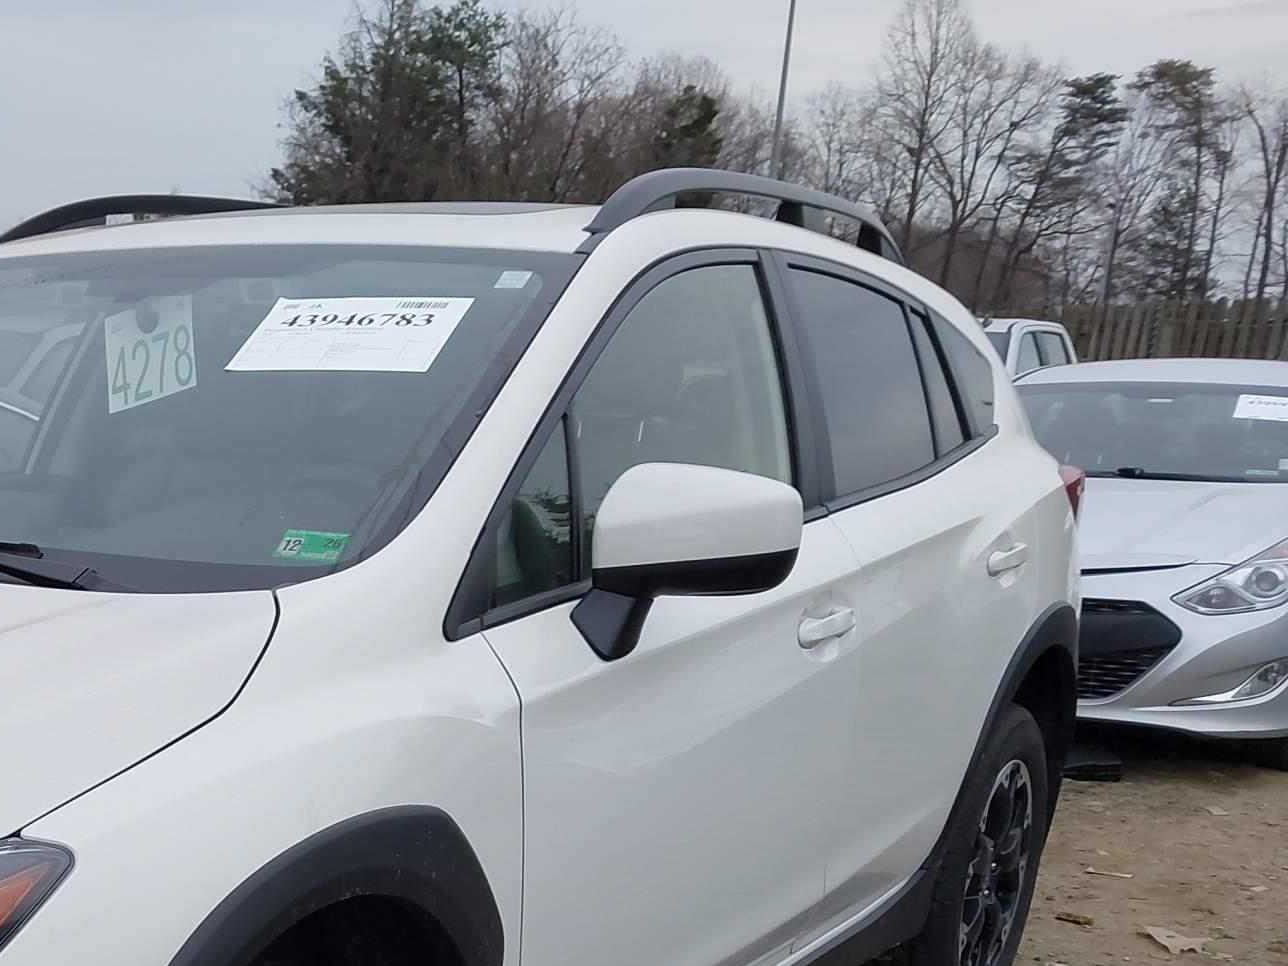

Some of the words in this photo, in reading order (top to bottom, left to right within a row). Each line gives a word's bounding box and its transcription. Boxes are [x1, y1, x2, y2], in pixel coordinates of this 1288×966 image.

[281, 312, 436, 327] 43946783
[112, 324, 193, 405] 4278
[282, 539, 303, 552] 12
